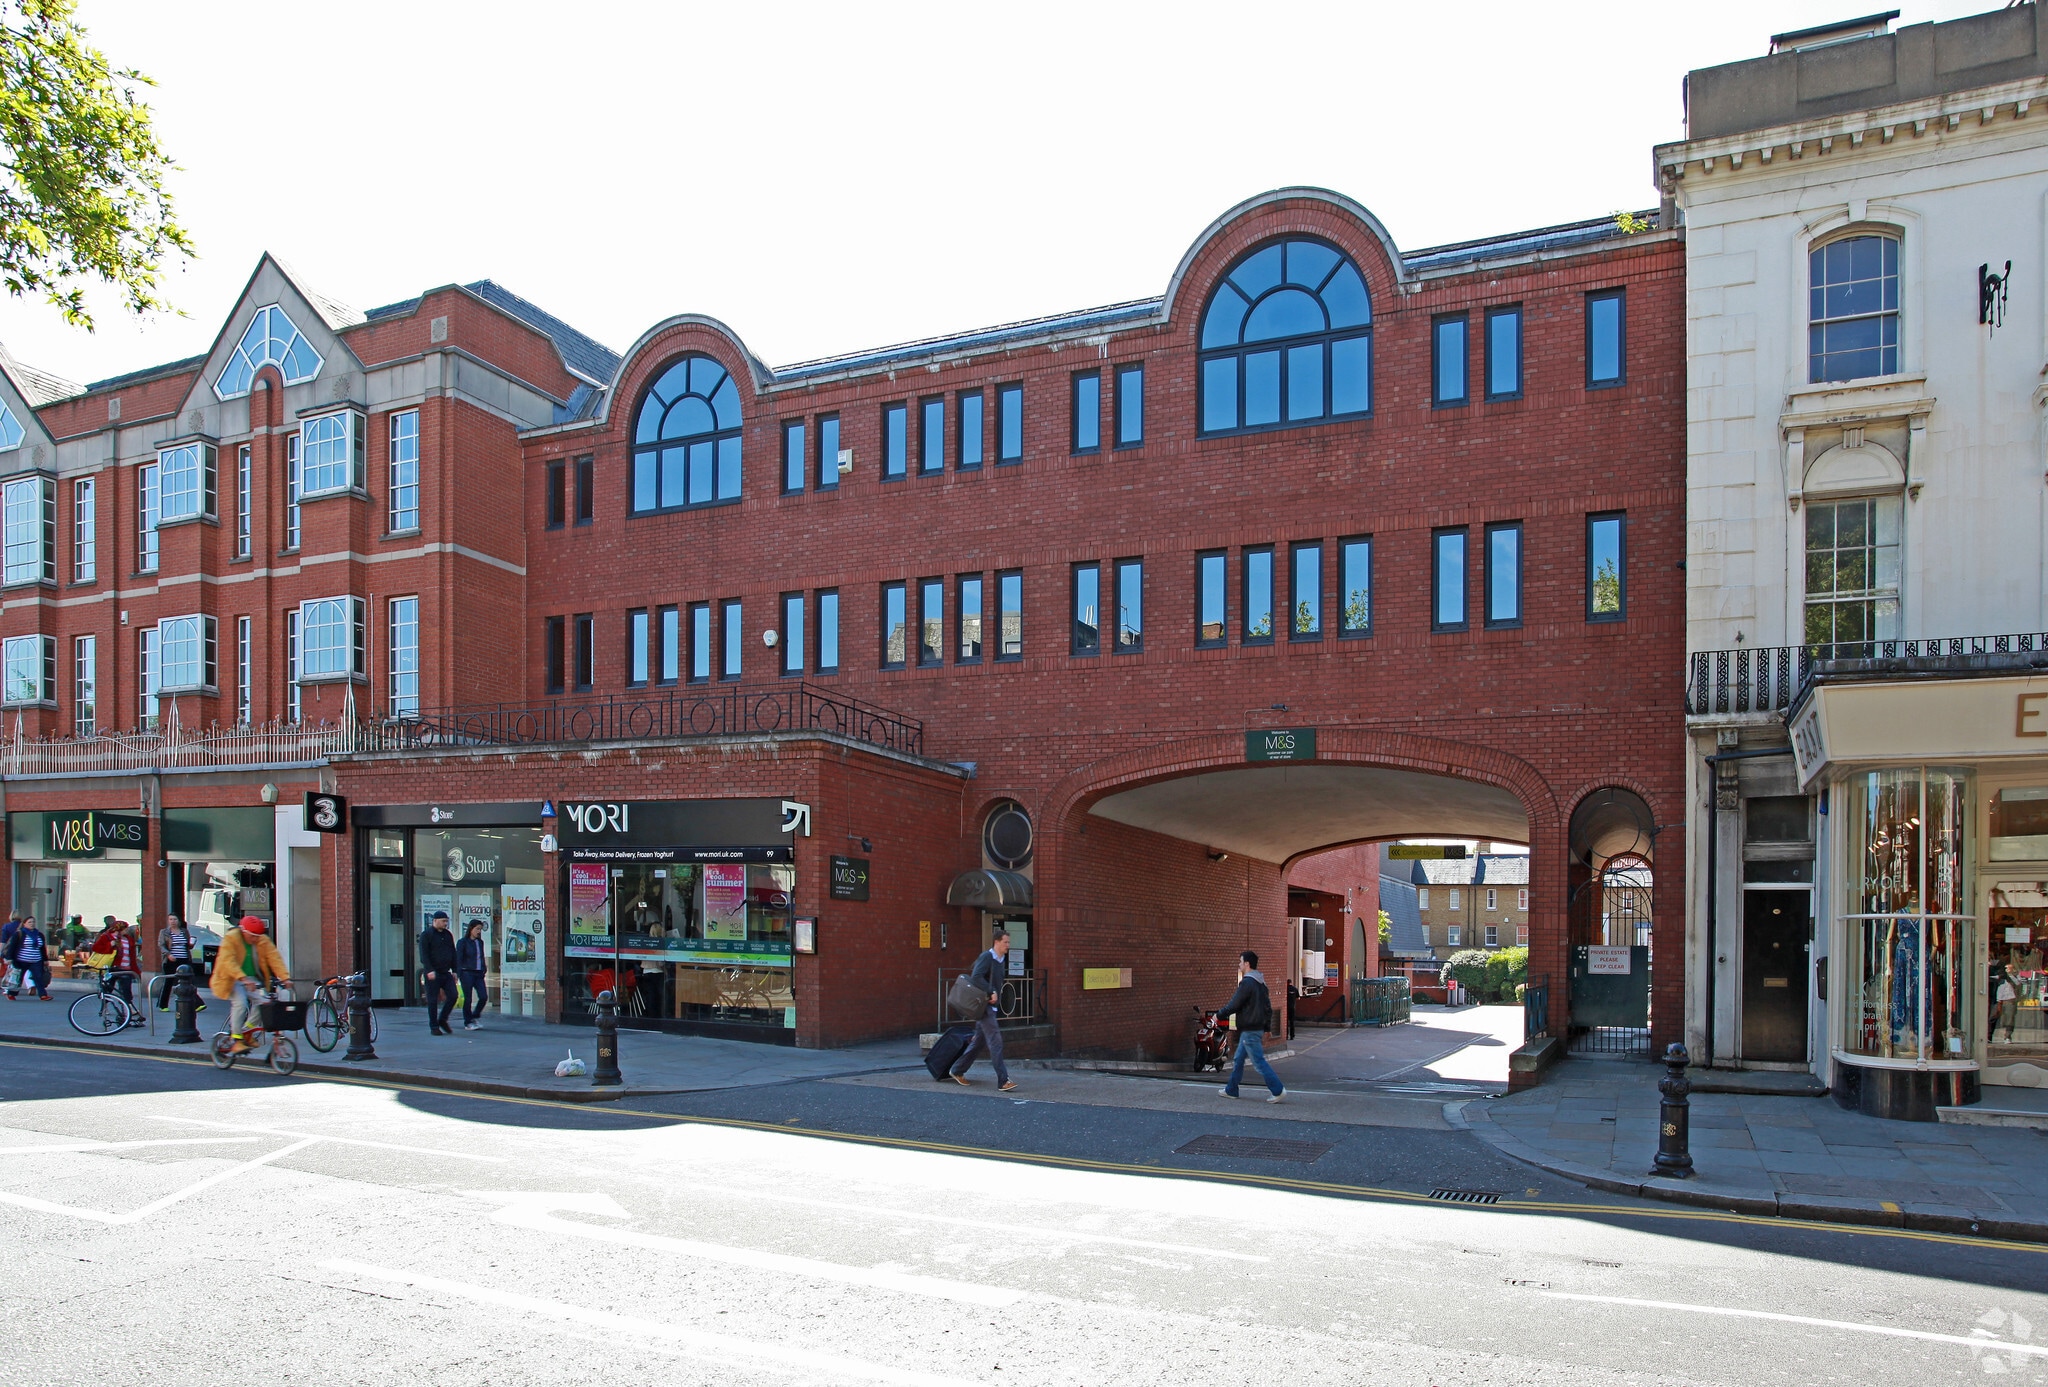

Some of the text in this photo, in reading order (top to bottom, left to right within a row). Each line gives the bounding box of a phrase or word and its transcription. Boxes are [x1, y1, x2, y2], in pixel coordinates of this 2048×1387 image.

[2015, 692, 2048, 737] E
[1265, 735, 1295, 749] M&S
[1795, 711, 1822, 769] EAST
[314, 797, 339, 829] 3
[431, 806, 440, 823] 3
[566, 803, 628, 833] MORI
[99, 822, 142, 841] M&S
[654, 851, 674, 859] Yoghurt
[1423, 849, 1430, 857] by
[1431, 848, 1442, 856] Car
[1446, 848, 1463, 856] M&S
[447, 846, 495, 881] 3 Store
[835, 867, 856, 884] M&S
[966, 879, 985, 896] 99
[459, 903, 491, 917] Amazing
[501, 895, 545, 911] Ultrafast
[570, 935, 591, 946] MORI
